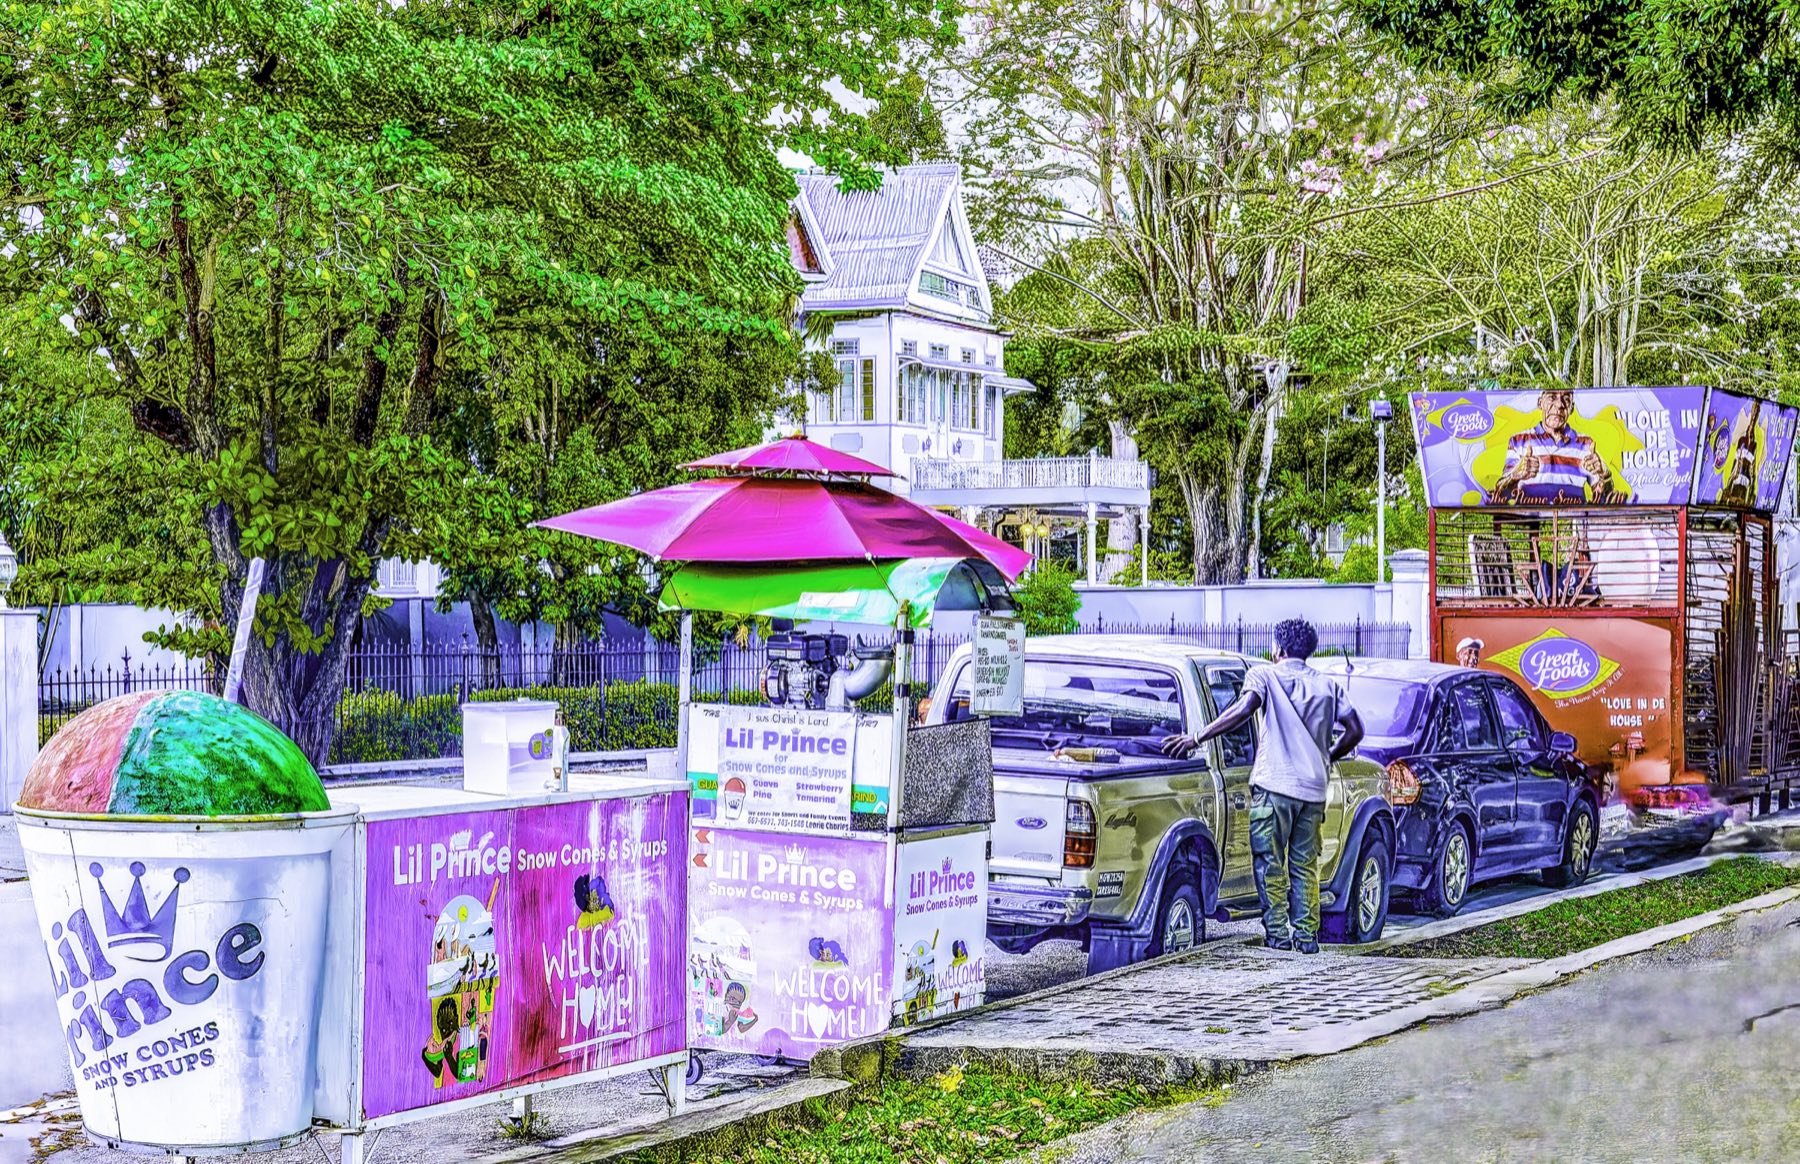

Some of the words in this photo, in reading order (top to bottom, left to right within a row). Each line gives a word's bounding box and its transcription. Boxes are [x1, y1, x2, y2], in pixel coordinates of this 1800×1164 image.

[1448, 411, 1480, 429] Great
[1450, 416, 1488, 438] Foods
[1680, 409, 1698, 430] IN
[1645, 430, 1667, 449] DE
[1530, 648, 1580, 675] Great
[1532, 657, 1591, 691] Foods
[1637, 697, 1648, 710] IN
[1652, 697, 1666, 710] DE
[748, 712, 769, 723] Jsus
[725, 728, 753, 750] Lil
[762, 730, 847, 756] Prince
[725, 761, 752, 773] Snow
[756, 762, 786, 775] Cones
[789, 765, 809, 776] and
[811, 766, 847, 780] Syrups
[774, 754, 788, 763] for
[753, 780, 778, 789] Guava
[796, 782, 844, 794] Strawberry
[753, 790, 772, 799] Pine
[393, 842, 423, 886] Lil
[430, 843, 512, 883] Prince
[517, 849, 558, 872] Snow
[560, 843, 606, 868] Cones
[608, 840, 619, 862] &
[621, 837, 669, 866] Syrups
[716, 851, 748, 884] Lil
[758, 853, 857, 892] Prince
[708, 882, 748, 899] Snow
[751, 885, 797, 904] Cones
[799, 890, 810, 905] &
[814, 892, 864, 911] Syrups
[910, 870, 926, 900] Lil
[930, 870, 975, 896] Prince
[906, 902, 925, 916] Snow
[926, 899, 948, 912] Cones
[948, 896, 954, 908] &
[954, 894, 978, 908] Syrups
[542, 912, 649, 985] WELCOME
[774, 965, 884, 1006] WELCOME
[938, 957, 984, 992] WELCOME
[66, 922, 266, 1069] rince
[82, 1051, 129, 1081] SNOW
[136, 1021, 220, 1063] CONES
[94, 1075, 118, 1091] AND
[124, 1048, 216, 1088] SYRUPS
